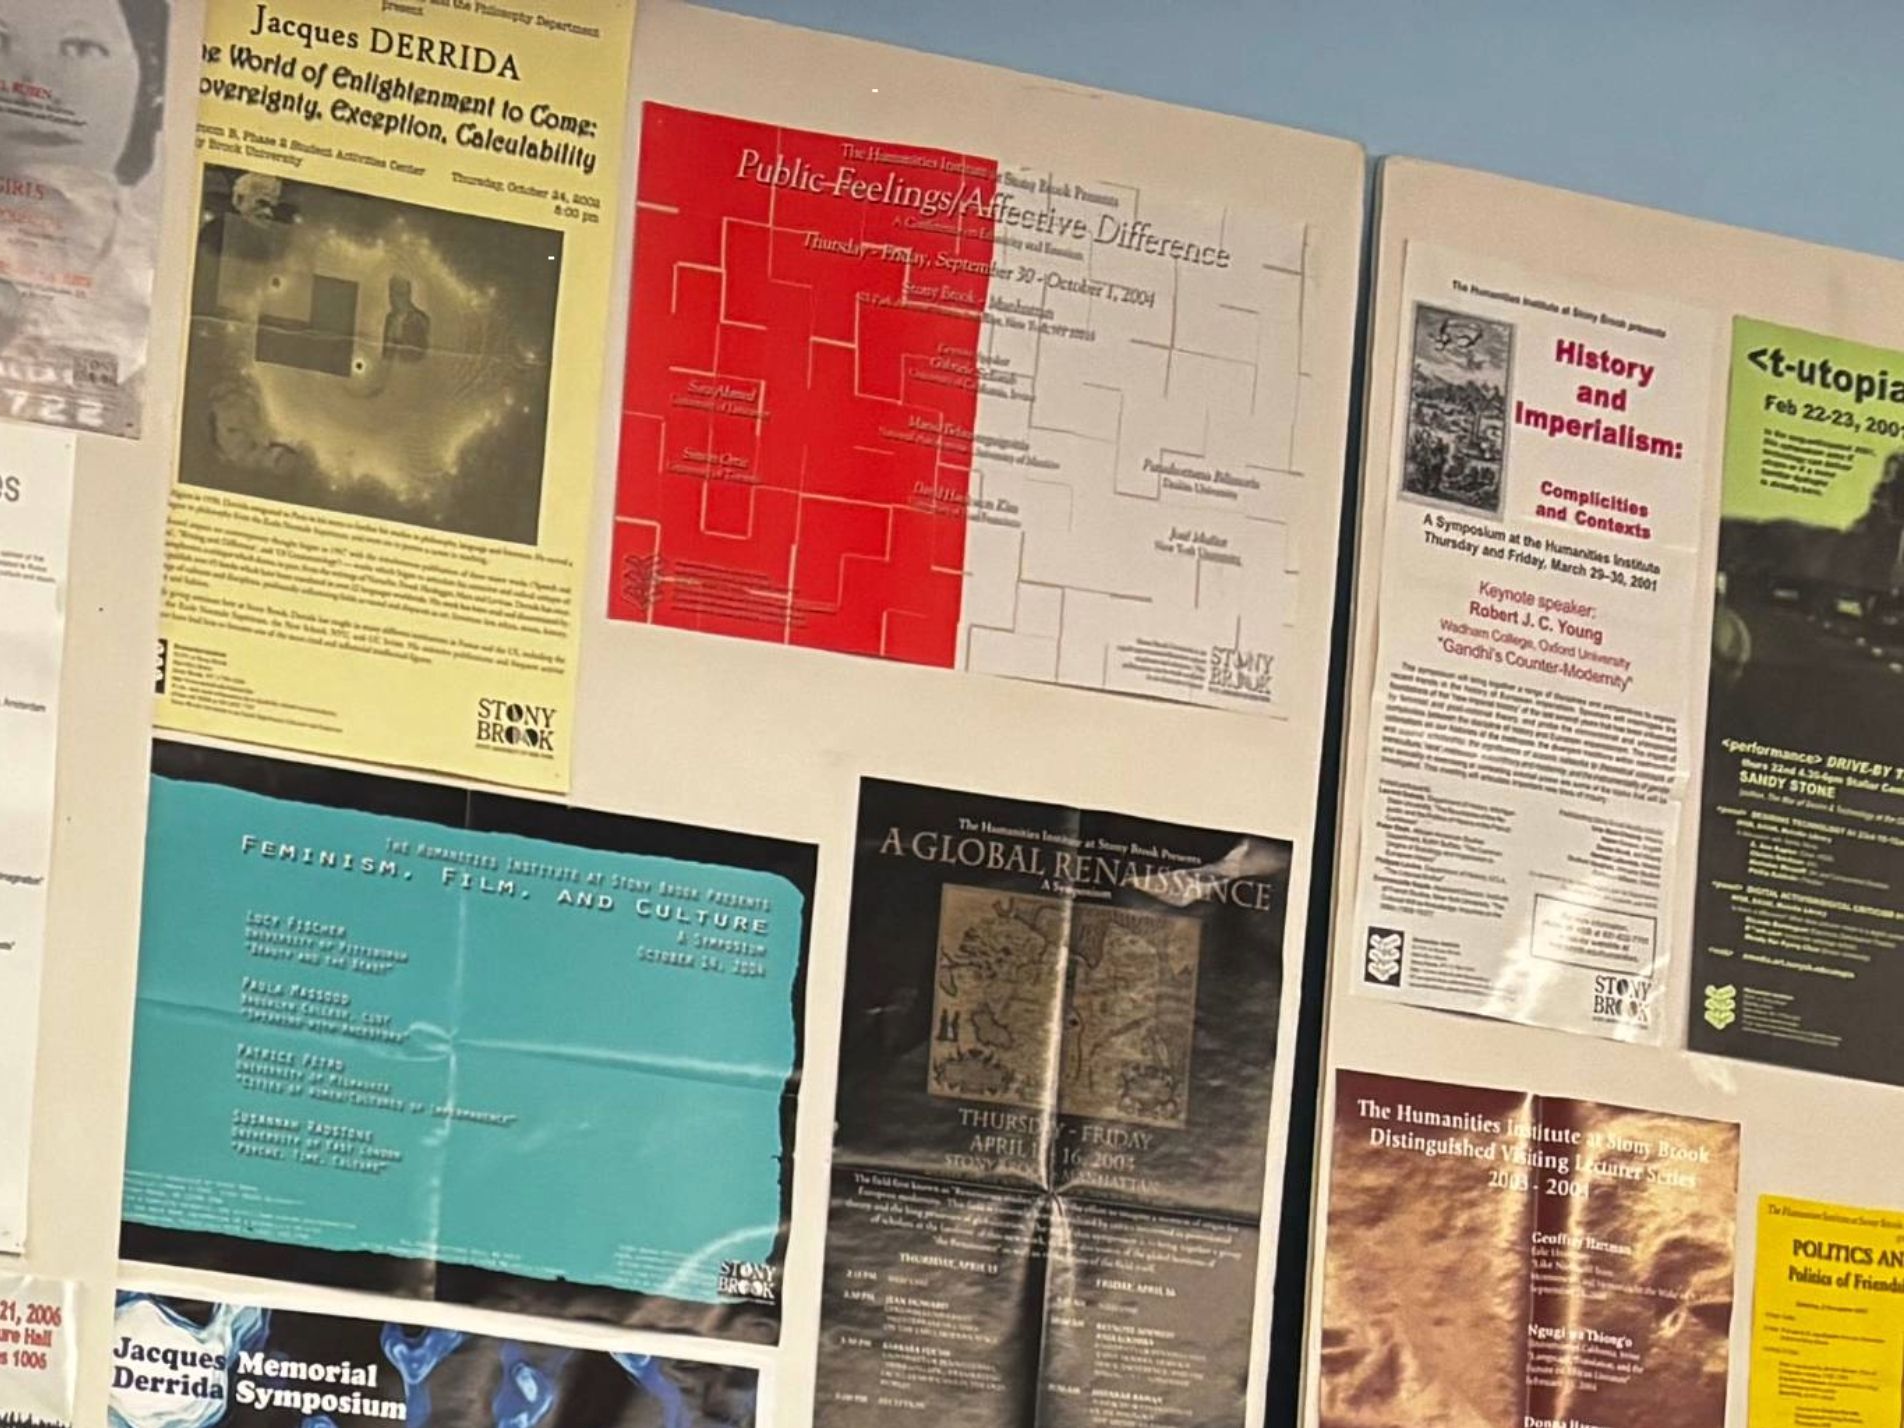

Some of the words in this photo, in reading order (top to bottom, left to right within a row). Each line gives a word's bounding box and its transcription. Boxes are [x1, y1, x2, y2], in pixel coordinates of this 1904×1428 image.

[250, 5, 359, 52] Jacques
[370, 28, 521, 81] DERRIDA
[330, 98, 447, 145] Exception,
[455, 122, 597, 175] Calculability
[735, 149, 823, 192] Public
[832, 165, 1088, 239] Feelings/Affective
[1094, 212, 1231, 269] Difference
[1555, 338, 1654, 388] History
[1576, 385, 1627, 412] and
[1515, 400, 1683, 460] Imperialism:
[1535, 504, 1568, 522] and
[1574, 509, 1651, 540] Contexts
[1540, 480, 1649, 518] Complicities
[879, 827, 904, 856] A
[911, 831, 1045, 876] GLOBAL
[1054, 851, 1280, 917] RENAISSANCE
[113, 1338, 227, 1371] Jacques
[237, 1351, 377, 1388] Memorial
[112, 1366, 225, 1401] Derrida
[235, 1382, 406, 1420] Symposium
